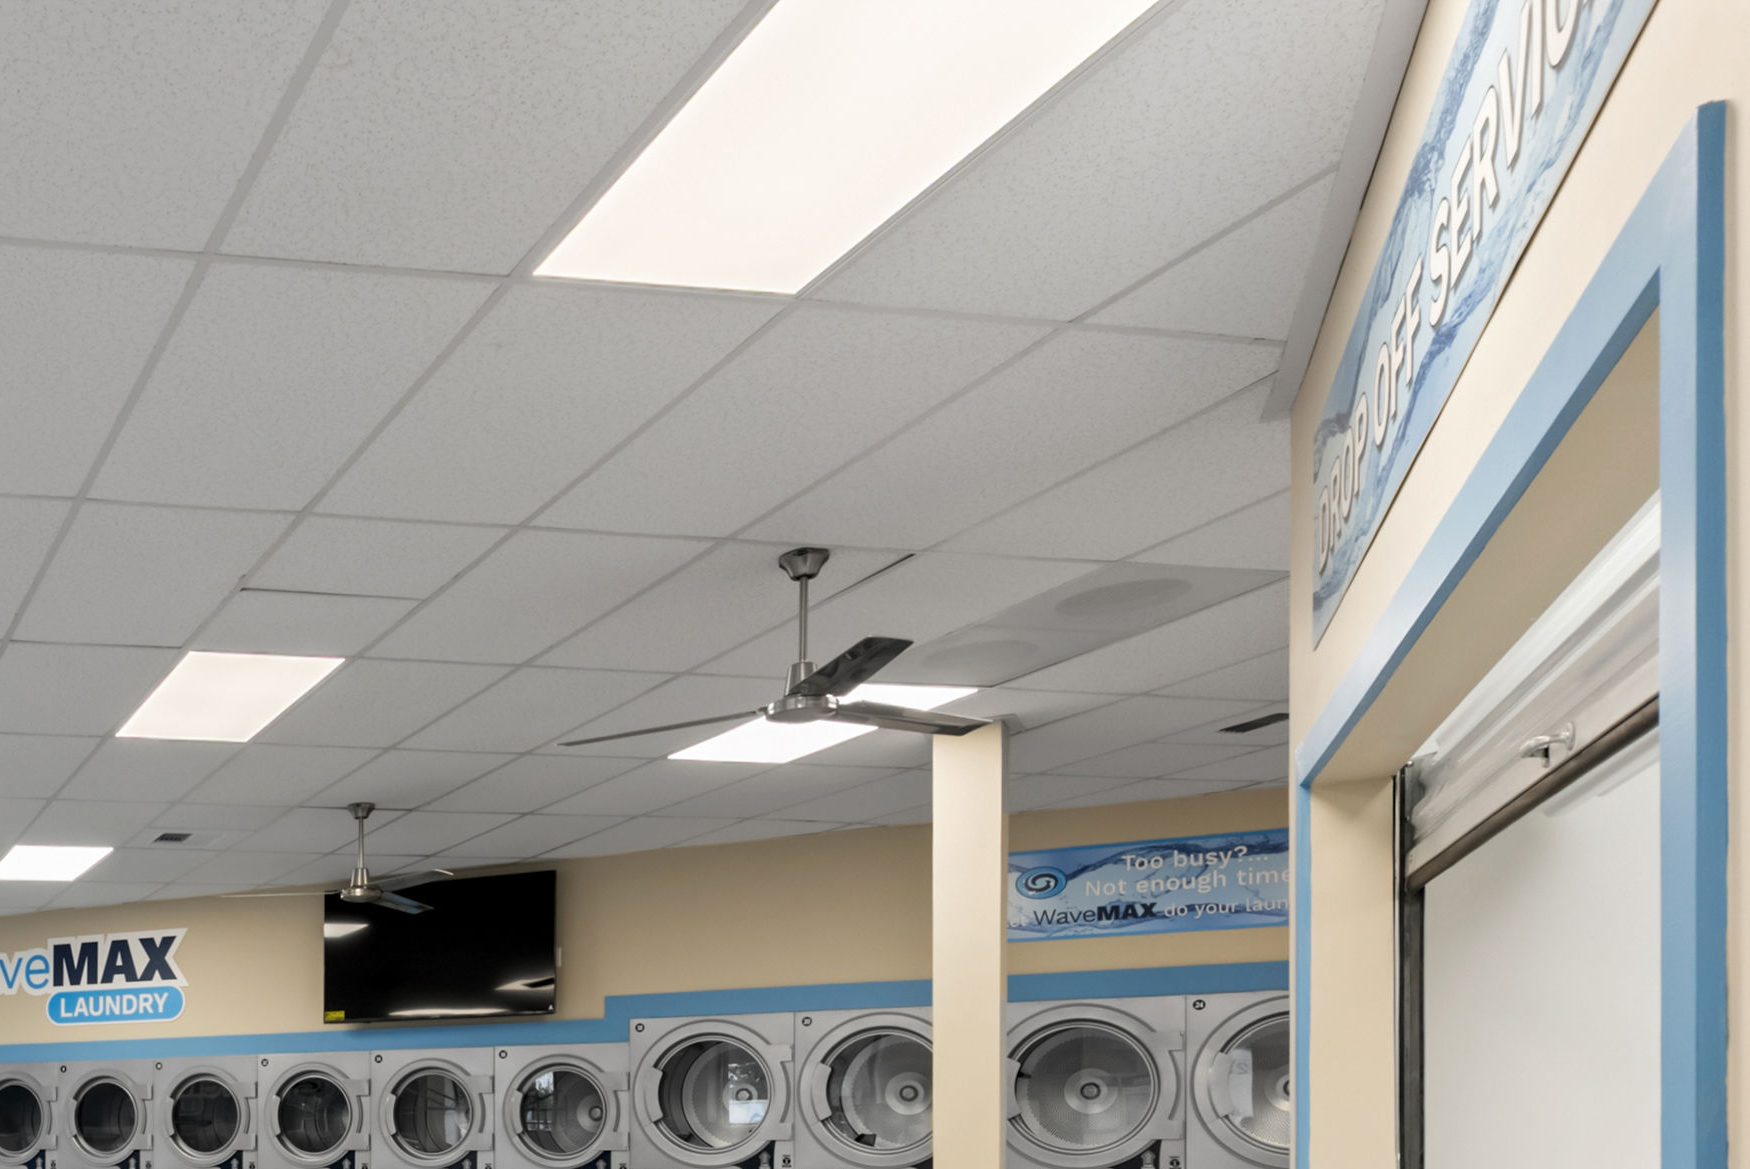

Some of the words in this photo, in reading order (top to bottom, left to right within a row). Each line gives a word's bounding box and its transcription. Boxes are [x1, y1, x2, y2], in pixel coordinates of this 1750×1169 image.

[1319, 392, 1369, 577] DROP
[1374, 255, 1423, 447] OFF
[1122, 854, 1164, 872] Too
[1085, 880, 1127, 897] Not
[1136, 868, 1227, 894] enough
[1033, 902, 1157, 926] WaveMAX
[1164, 903, 1188, 918] do
[1195, 901, 1238, 919] your
[60, 992, 169, 1018] LAUNDRY
